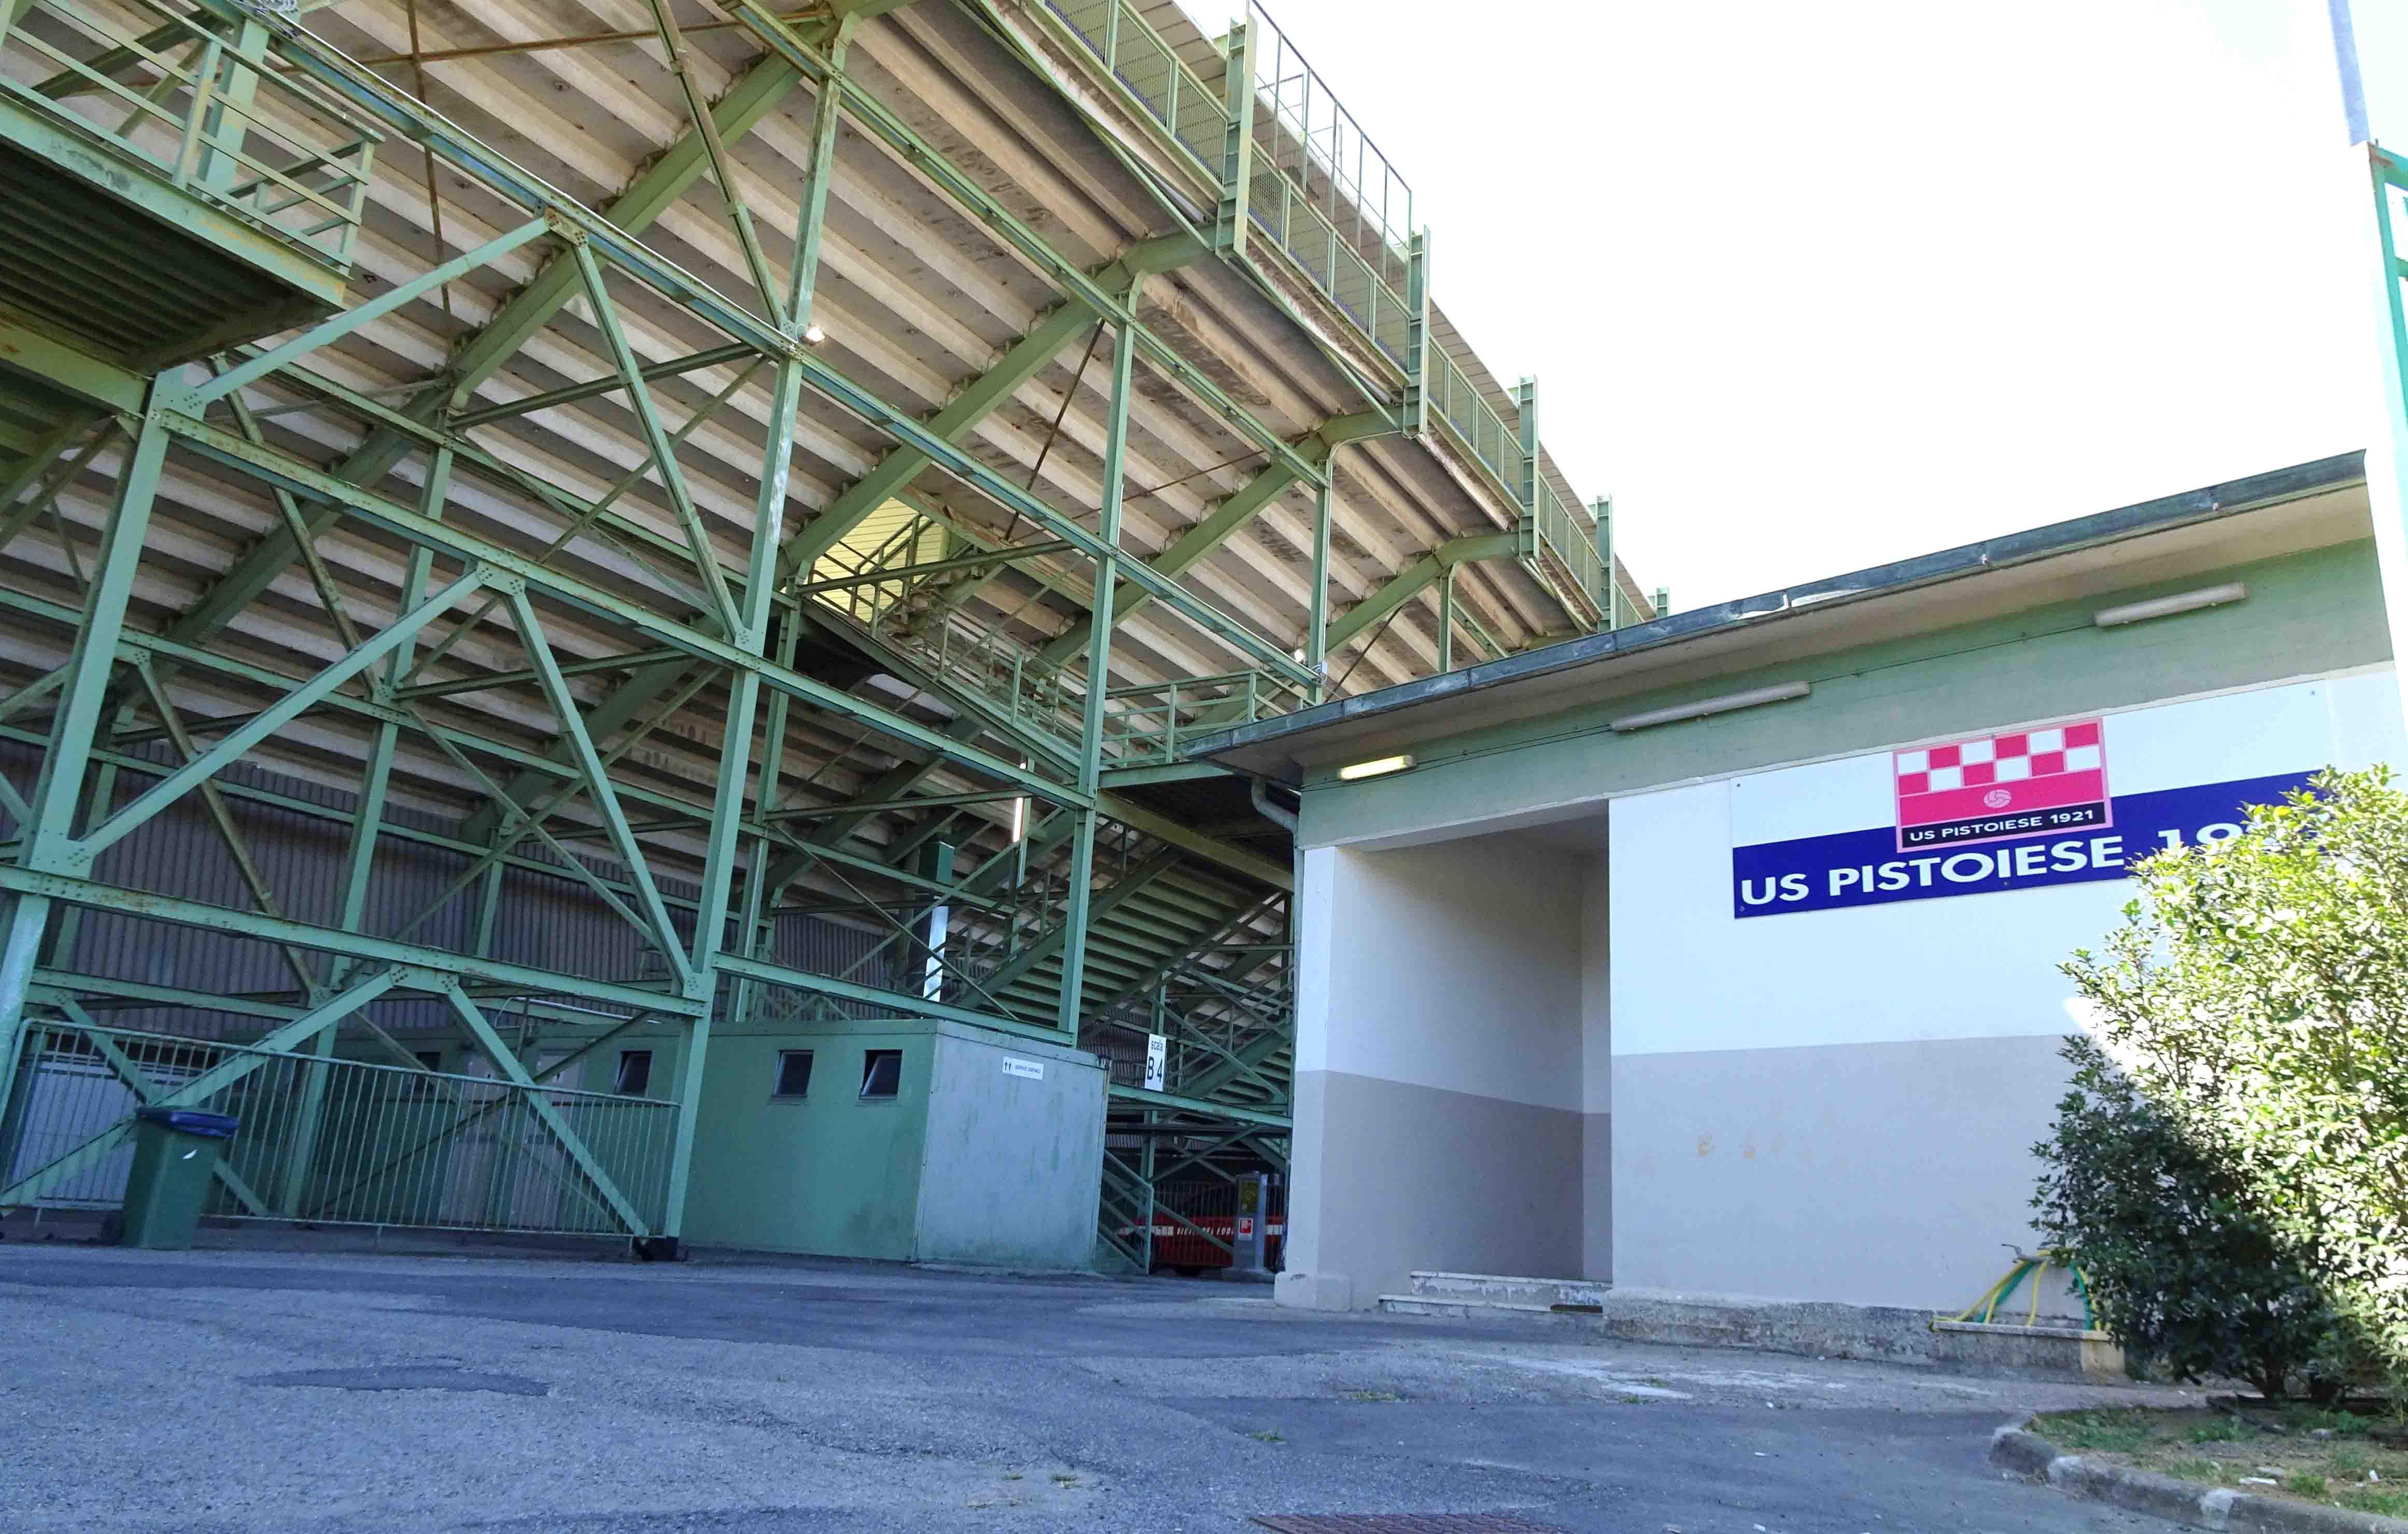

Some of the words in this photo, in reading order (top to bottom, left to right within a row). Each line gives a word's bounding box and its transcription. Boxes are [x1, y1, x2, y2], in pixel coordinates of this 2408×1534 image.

[1910, 831, 1935, 842] US
[1942, 817, 2042, 837] PISTOIESE
[2050, 810, 2094, 823] 1921
[1741, 873, 1809, 905] US
[1829, 835, 2124, 896] PISTOIESE
[1147, 1056, 1154, 1080] B
[1157, 1058, 1163, 1083] 4
